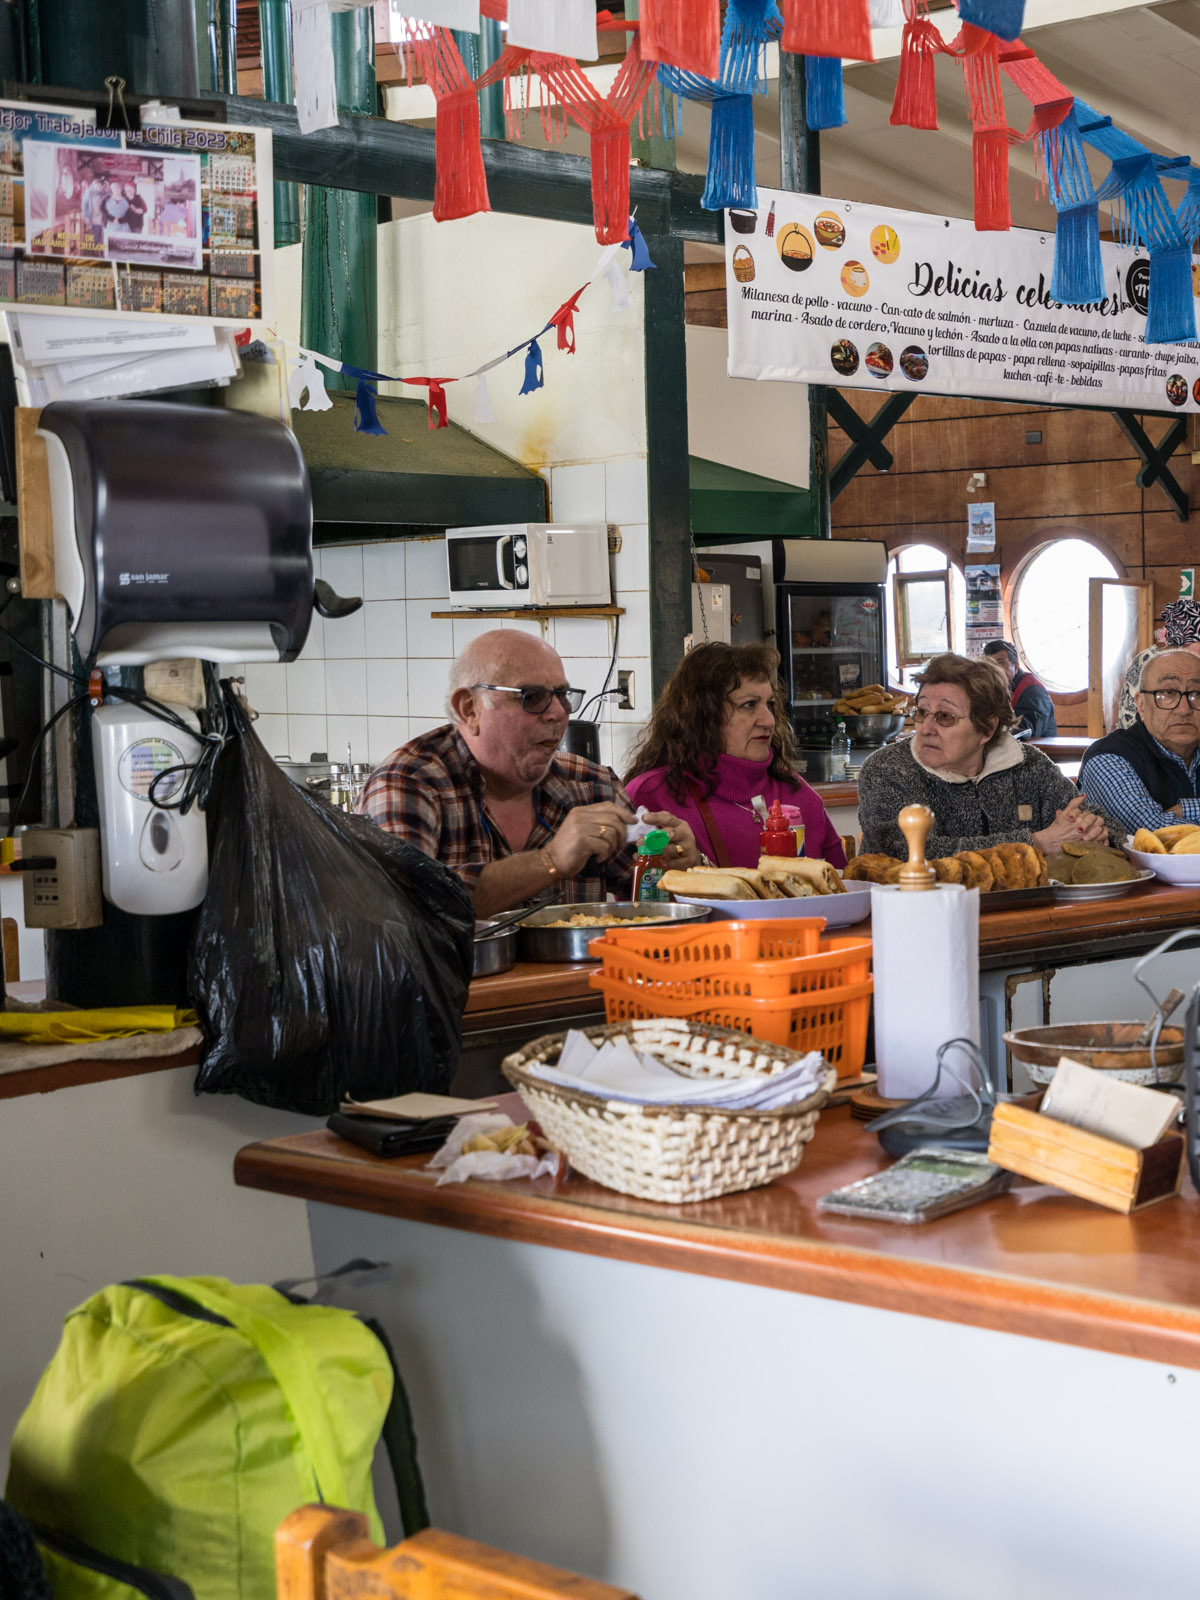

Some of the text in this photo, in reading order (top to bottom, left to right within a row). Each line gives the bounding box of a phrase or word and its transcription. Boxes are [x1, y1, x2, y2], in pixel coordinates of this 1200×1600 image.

[147, 126, 181, 145] Chile
[185, 130, 226, 148] 2023
[908, 260, 1008, 303] Delicias
[741, 286, 789, 303] Milanesa
[792, 293, 803, 306] de
[804, 296, 829, 309] pollo
[837, 301, 873, 313] vacuno
[881, 302, 923, 319] Can-cato
[925, 308, 936, 320] de
[937, 310, 971, 325] salmón
[978, 315, 1014, 329] merluza
[1023, 318, 1056, 333] Cazuela
[1058, 322, 1069, 334] de
[1069, 327, 1100, 339] vacuno,
[1101, 329, 1112, 340] de
[1113, 329, 1132, 341] luche
[751, 309, 793, 323] marina
[801, 311, 834, 327] Asado
[835, 316, 847, 329] de
[927, 329, 934, 341] y
[935, 327, 963, 342] lechón
[970, 330, 1001, 344] Asado
[1002, 337, 1008, 345] a
[1010, 334, 1019, 347] la
[1020, 336, 1037, 349] olla
[1039, 341, 1054, 350] con
[1055, 343, 1081, 356] papas
[1082, 343, 1113, 356] nativas
[1155, 351, 1175, 365] chupe
[1174, 352, 1199, 366] jaiba,
[928, 344, 965, 359] tortillas
[967, 348, 978, 360] de
[978, 352, 1006, 364] papas
[1013, 355, 1035, 367] papa
[1037, 355, 1066, 368] rellena
[1144, 366, 1168, 379] fritas
[1003, 369, 1032, 382] kuchen
[1071, 375, 1103, 388] bebidas
